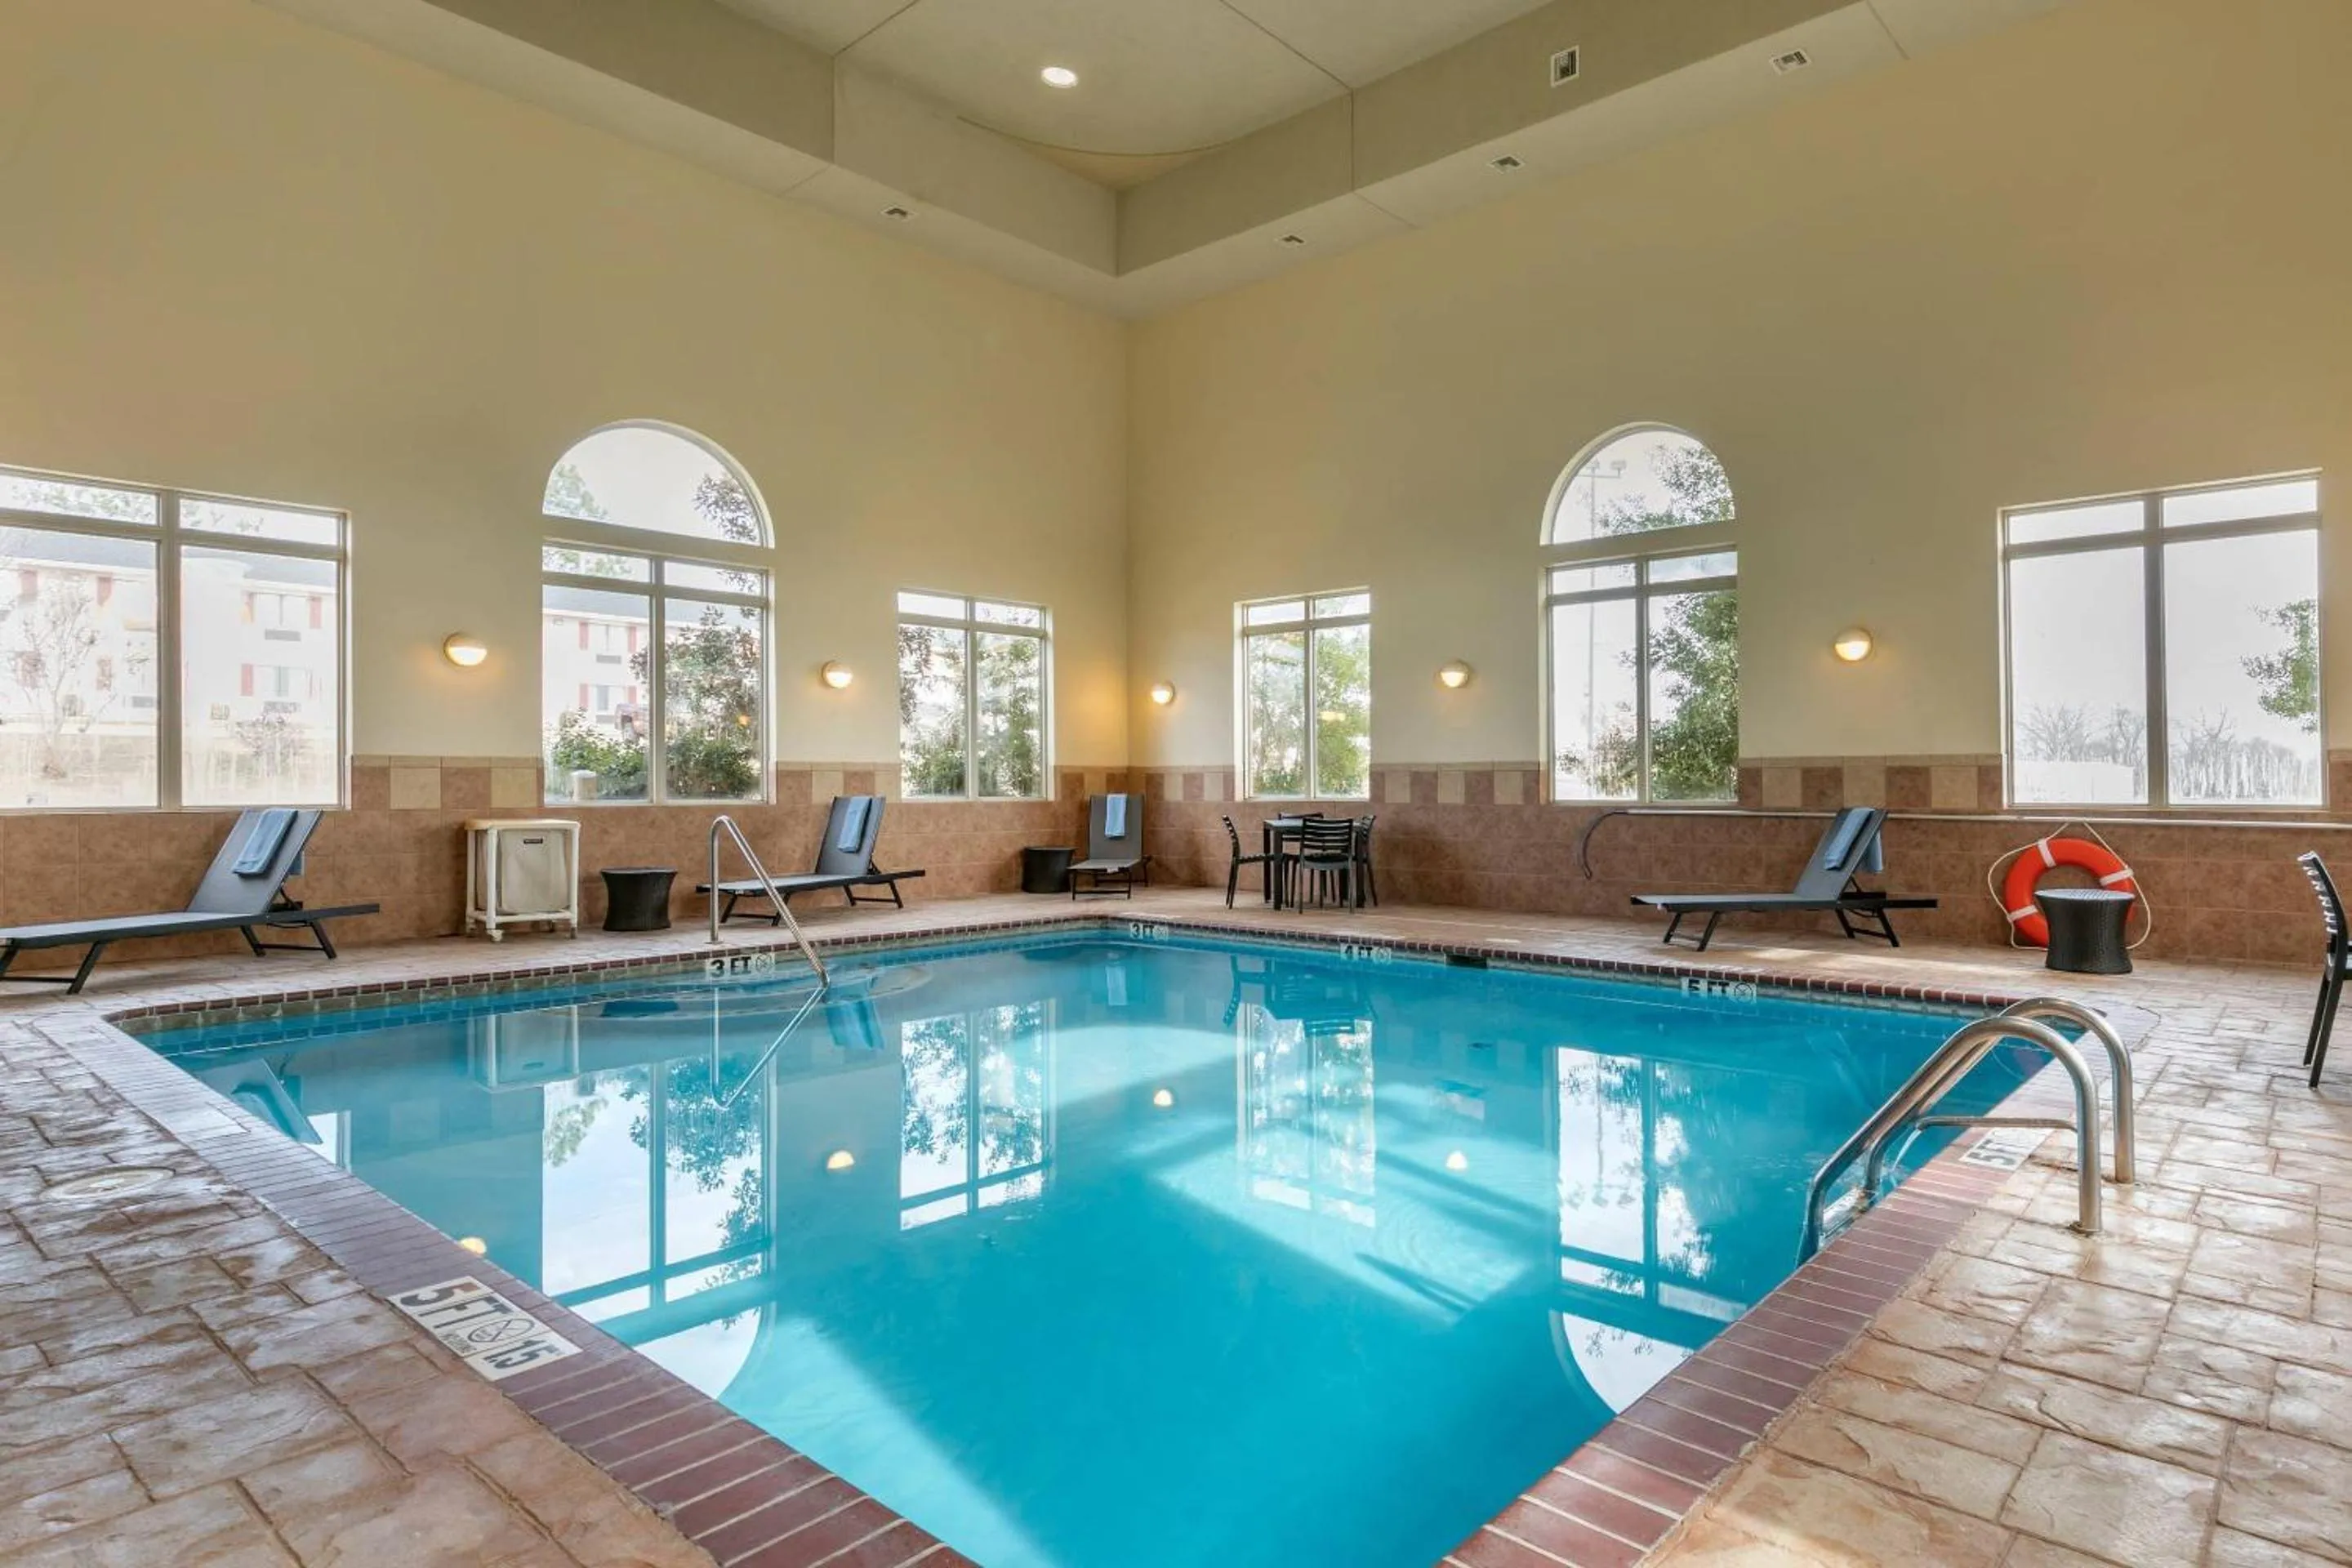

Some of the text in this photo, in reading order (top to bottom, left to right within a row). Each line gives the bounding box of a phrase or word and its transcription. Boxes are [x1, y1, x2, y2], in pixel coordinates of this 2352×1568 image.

[710, 959, 725, 977] 3
[1966, 1138, 2028, 1165] 5 FT
[400, 1281, 481, 1307] 5
[417, 1295, 514, 1330] FT
